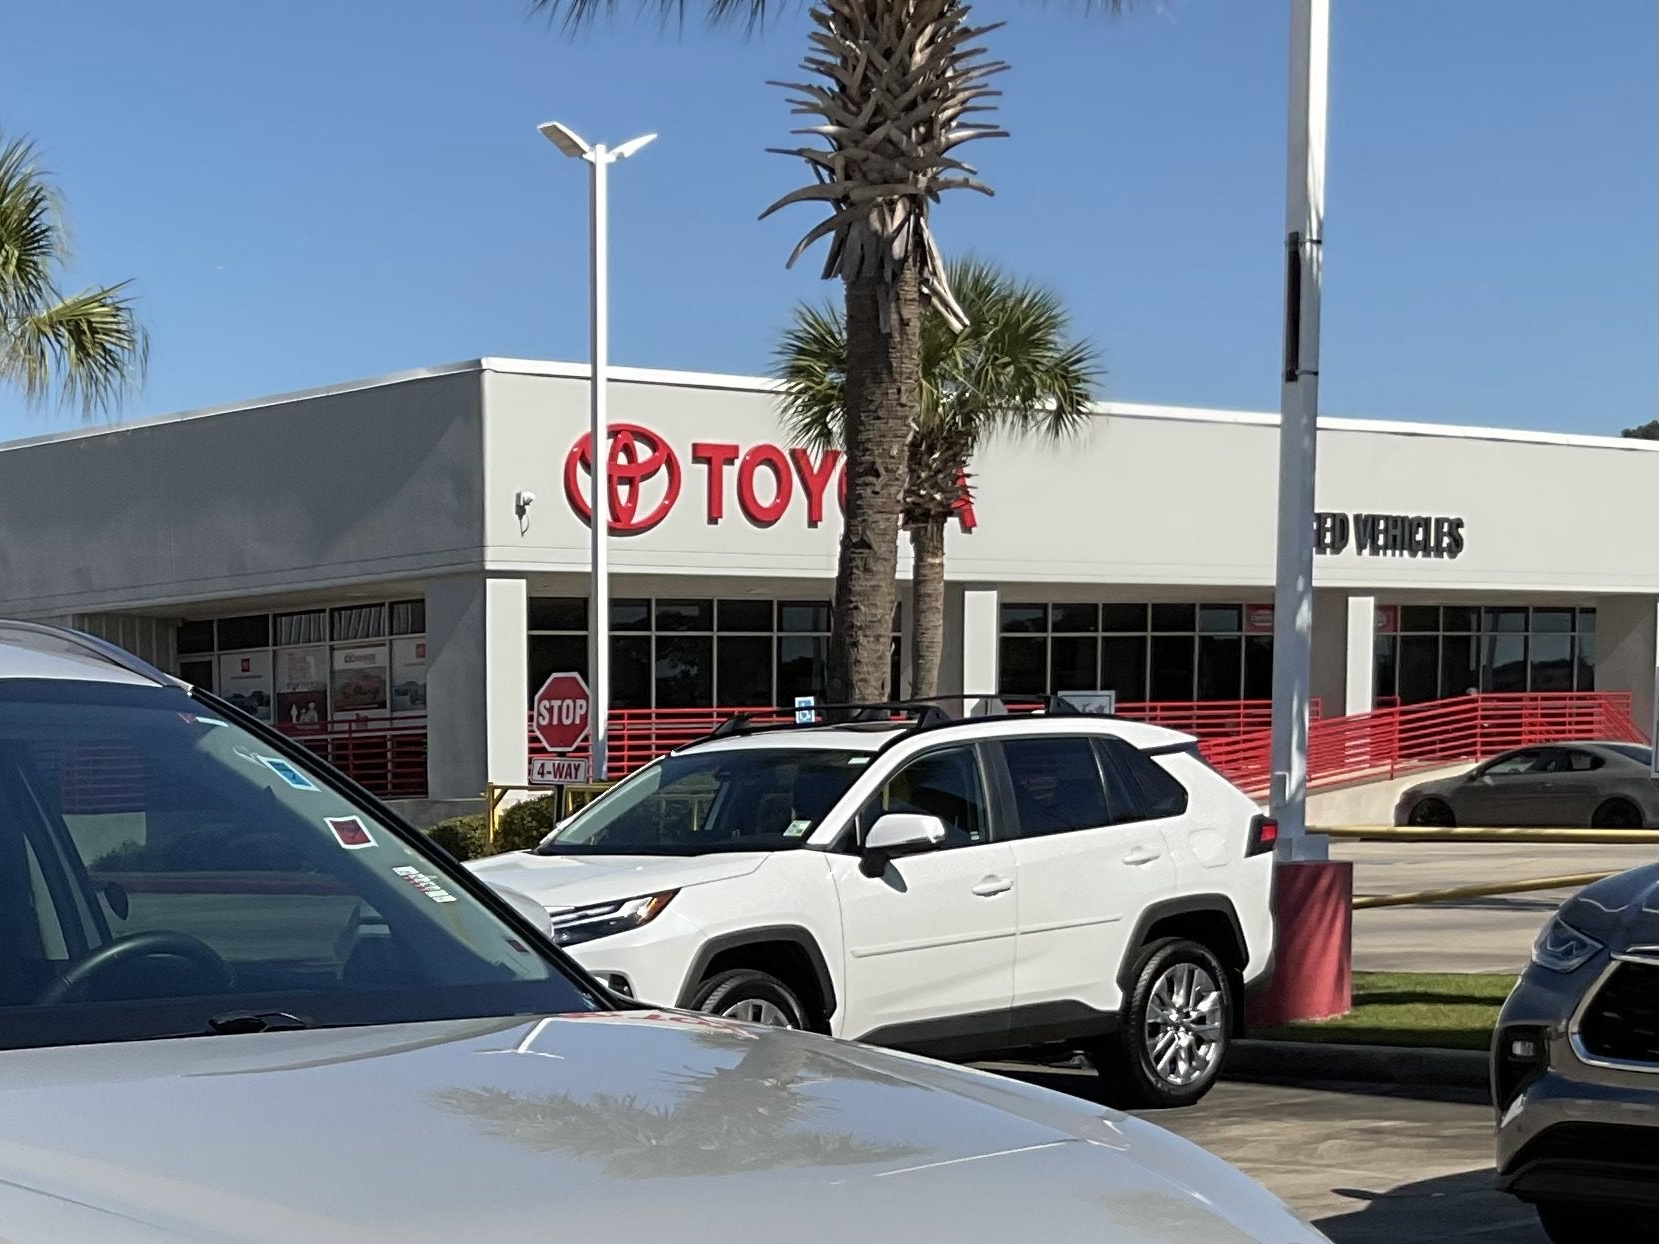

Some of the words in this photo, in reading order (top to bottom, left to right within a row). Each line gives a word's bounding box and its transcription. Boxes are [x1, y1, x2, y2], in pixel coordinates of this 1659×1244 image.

[692, 443, 977, 529] TOY
[1314, 512, 1349, 556] ED
[1353, 513, 1465, 559] VEHICLES
[538, 698, 588, 726] STOP
[537, 762, 582, 780] 4-WAY
